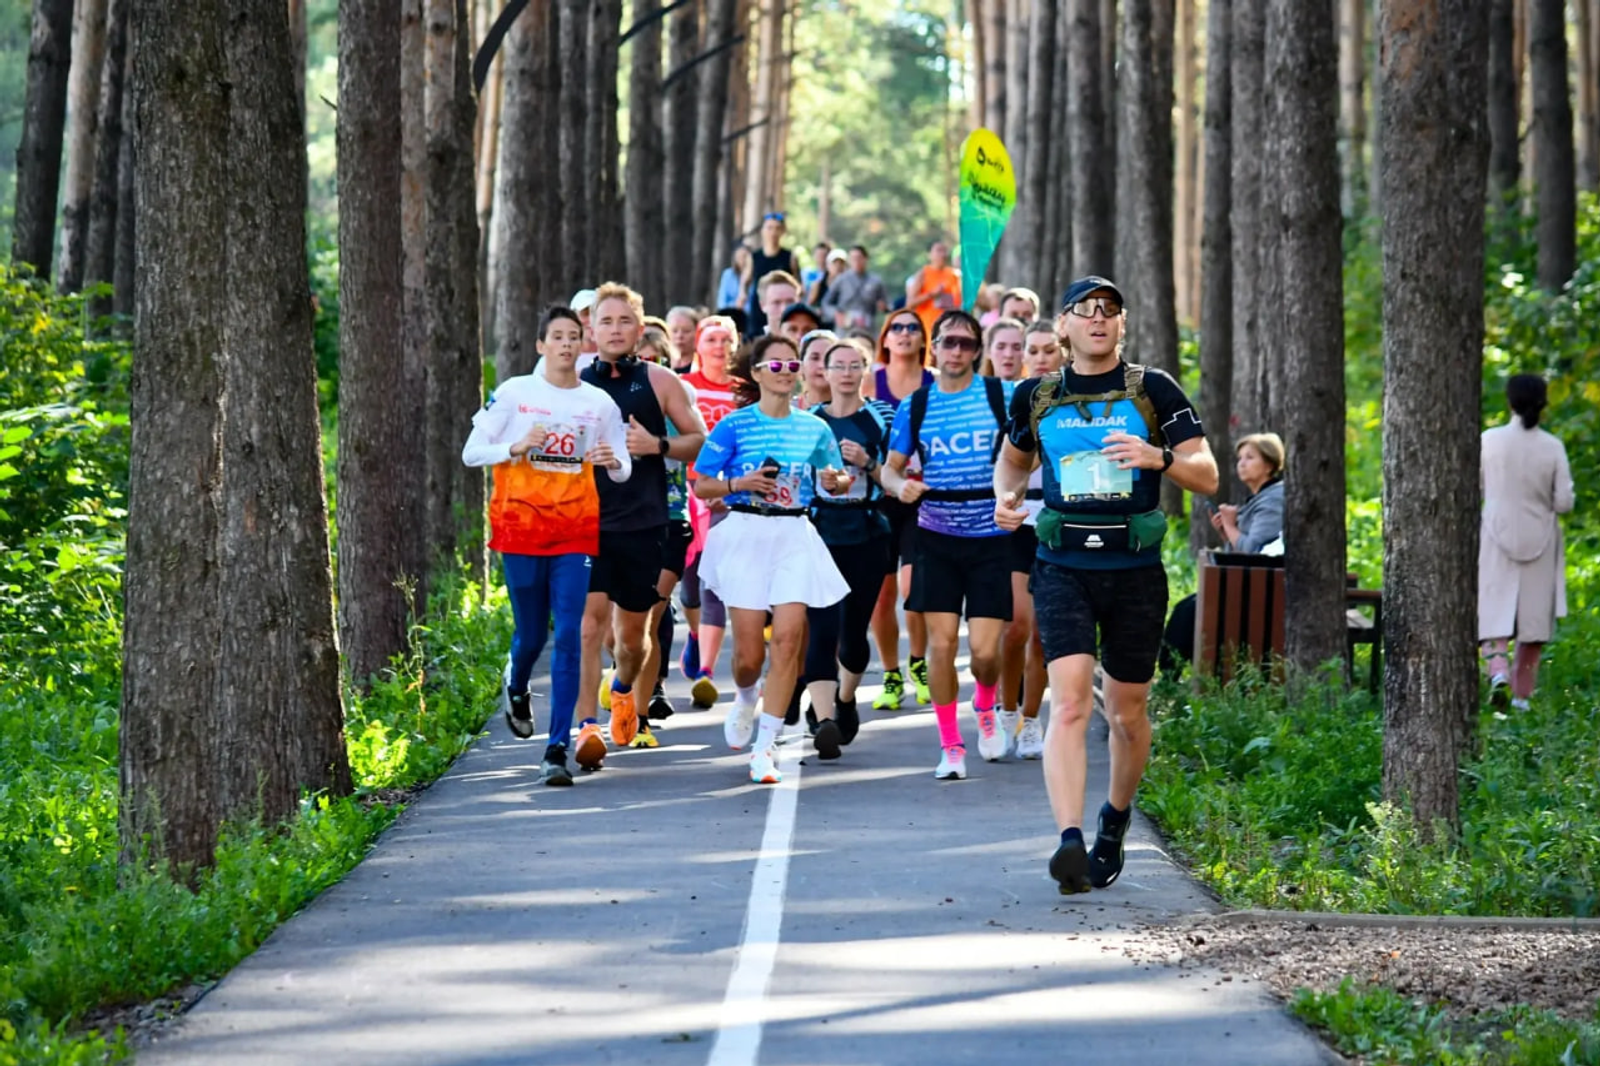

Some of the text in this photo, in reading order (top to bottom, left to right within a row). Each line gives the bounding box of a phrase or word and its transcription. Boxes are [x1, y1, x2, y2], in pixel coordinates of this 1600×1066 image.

[1057, 416, 1128, 429] MALIDAK
[545, 432, 575, 456] 26
[742, 461, 812, 480] PER
[1087, 462, 1102, 490] 1
